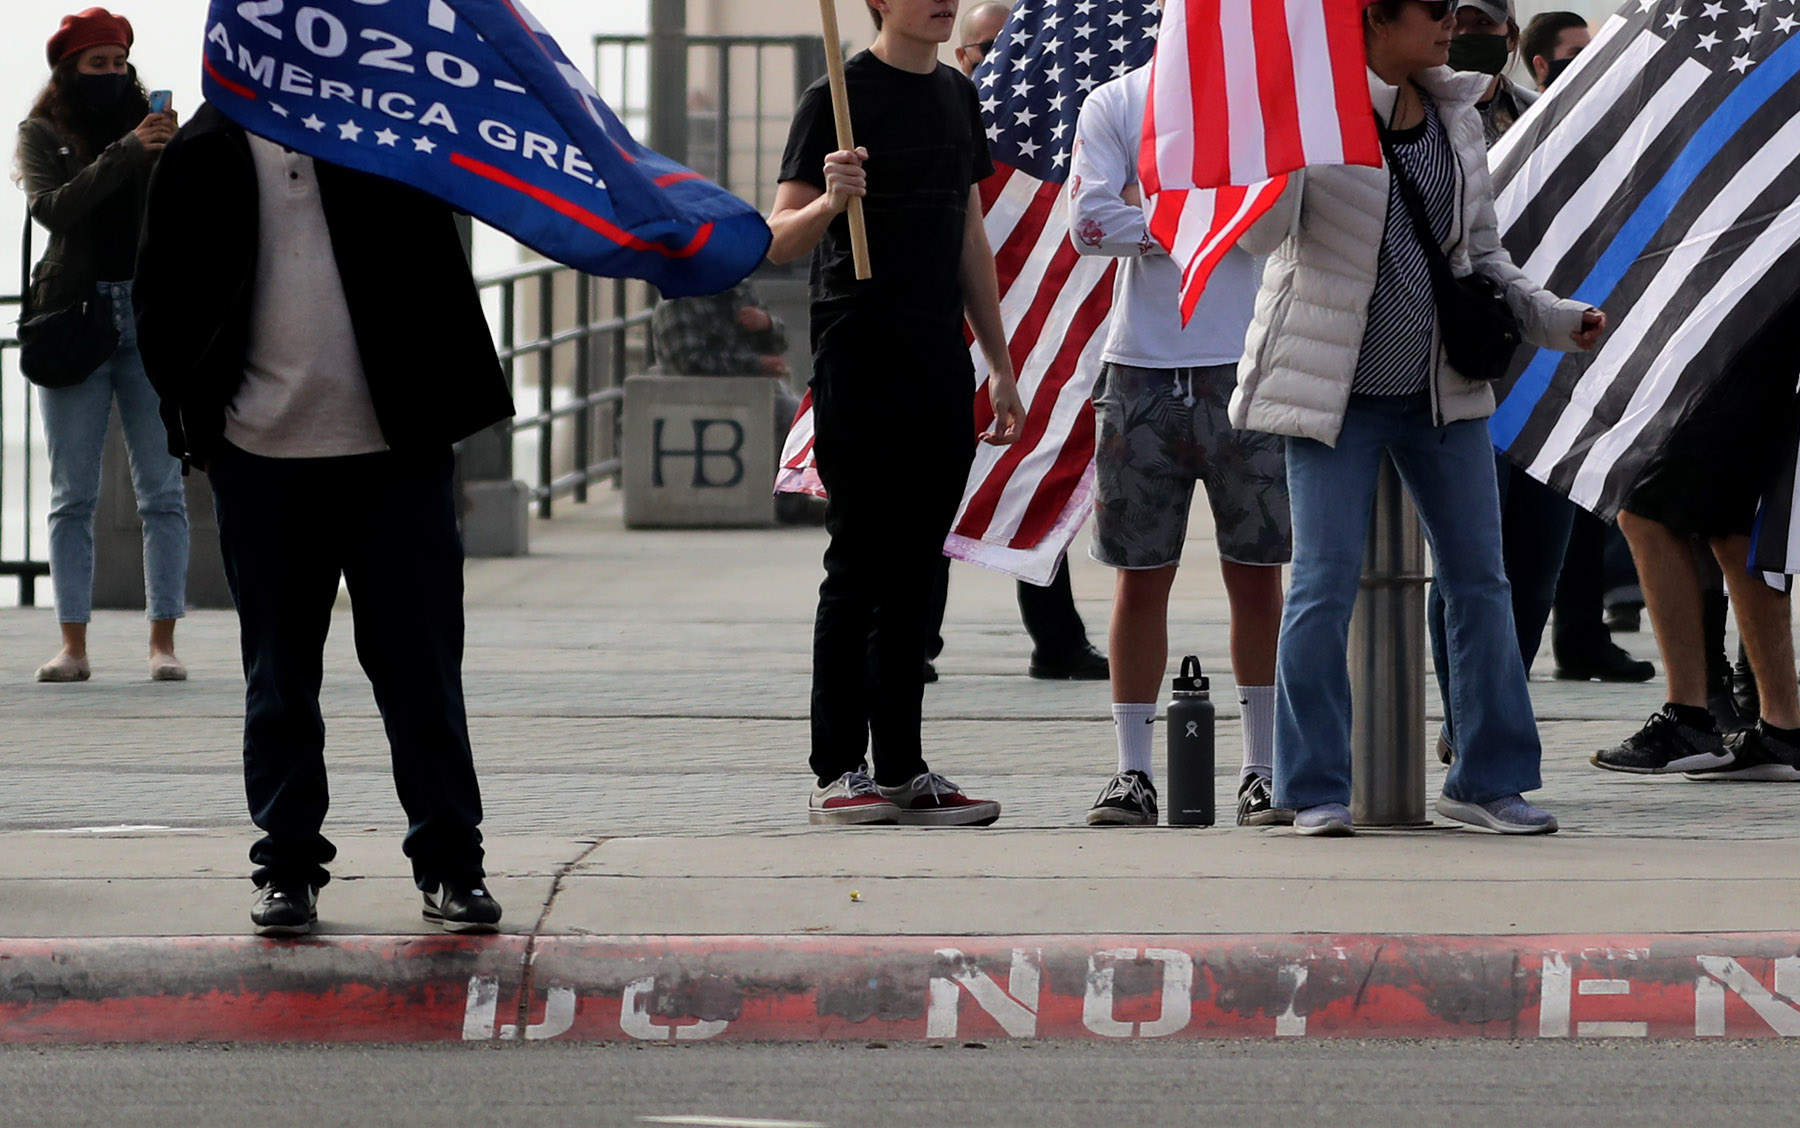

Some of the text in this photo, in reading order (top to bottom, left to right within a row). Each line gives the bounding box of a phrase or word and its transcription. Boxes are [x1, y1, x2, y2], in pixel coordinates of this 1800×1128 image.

[207, 21, 607, 190] AMERICA GRE
[651, 418, 745, 488] HB
